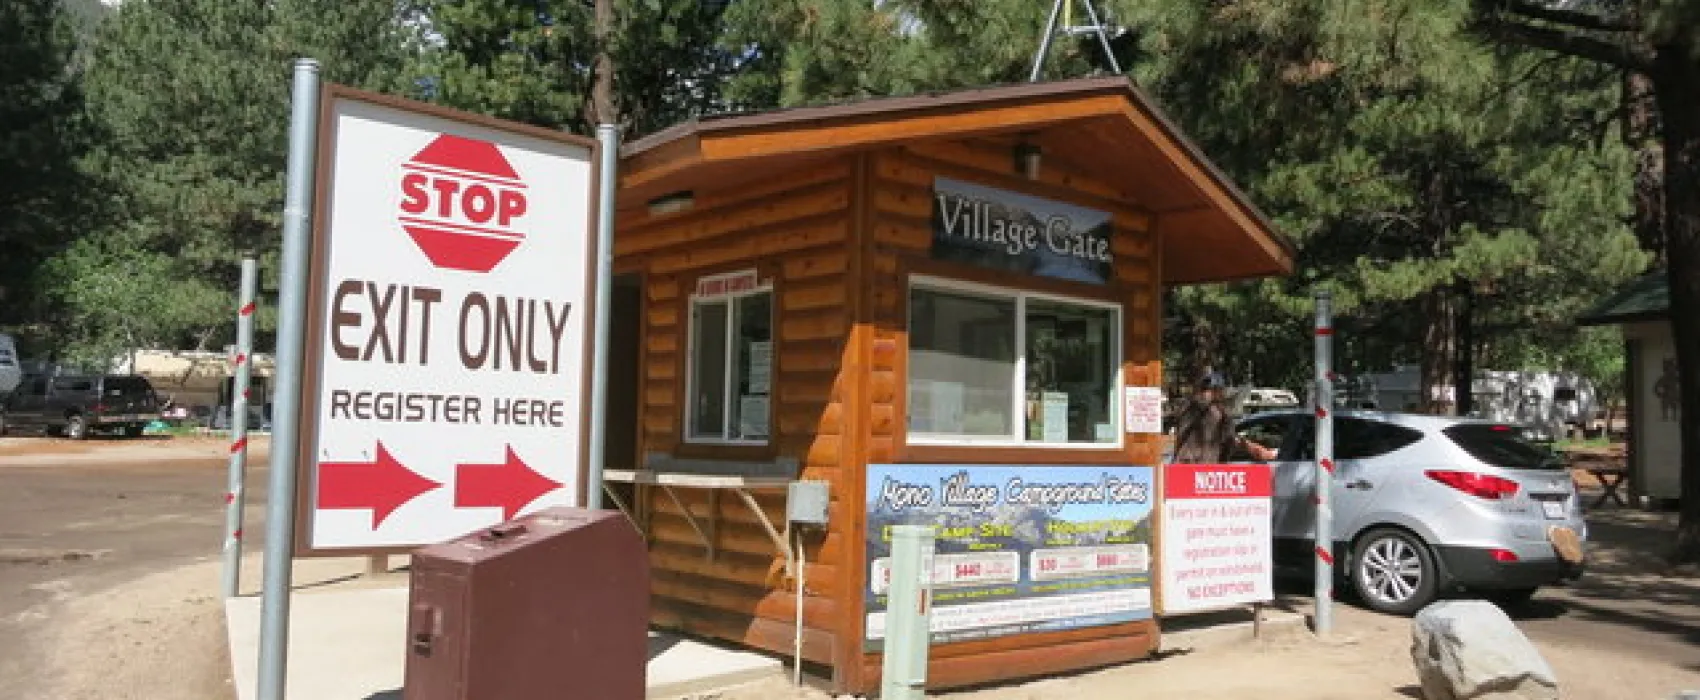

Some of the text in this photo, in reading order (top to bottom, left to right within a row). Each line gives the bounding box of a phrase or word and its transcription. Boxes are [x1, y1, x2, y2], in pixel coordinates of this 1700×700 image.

[401, 174, 527, 226] STOP
[938, 193, 1114, 263] Village Gate
[331, 278, 572, 375] EXIT ONLY
[331, 388, 565, 428] REGISTER HERE
[877, 476, 931, 511] Mono
[939, 471, 999, 513] Village
[1003, 474, 1104, 515] Campground
[1195, 471, 1247, 491] NOTICE
